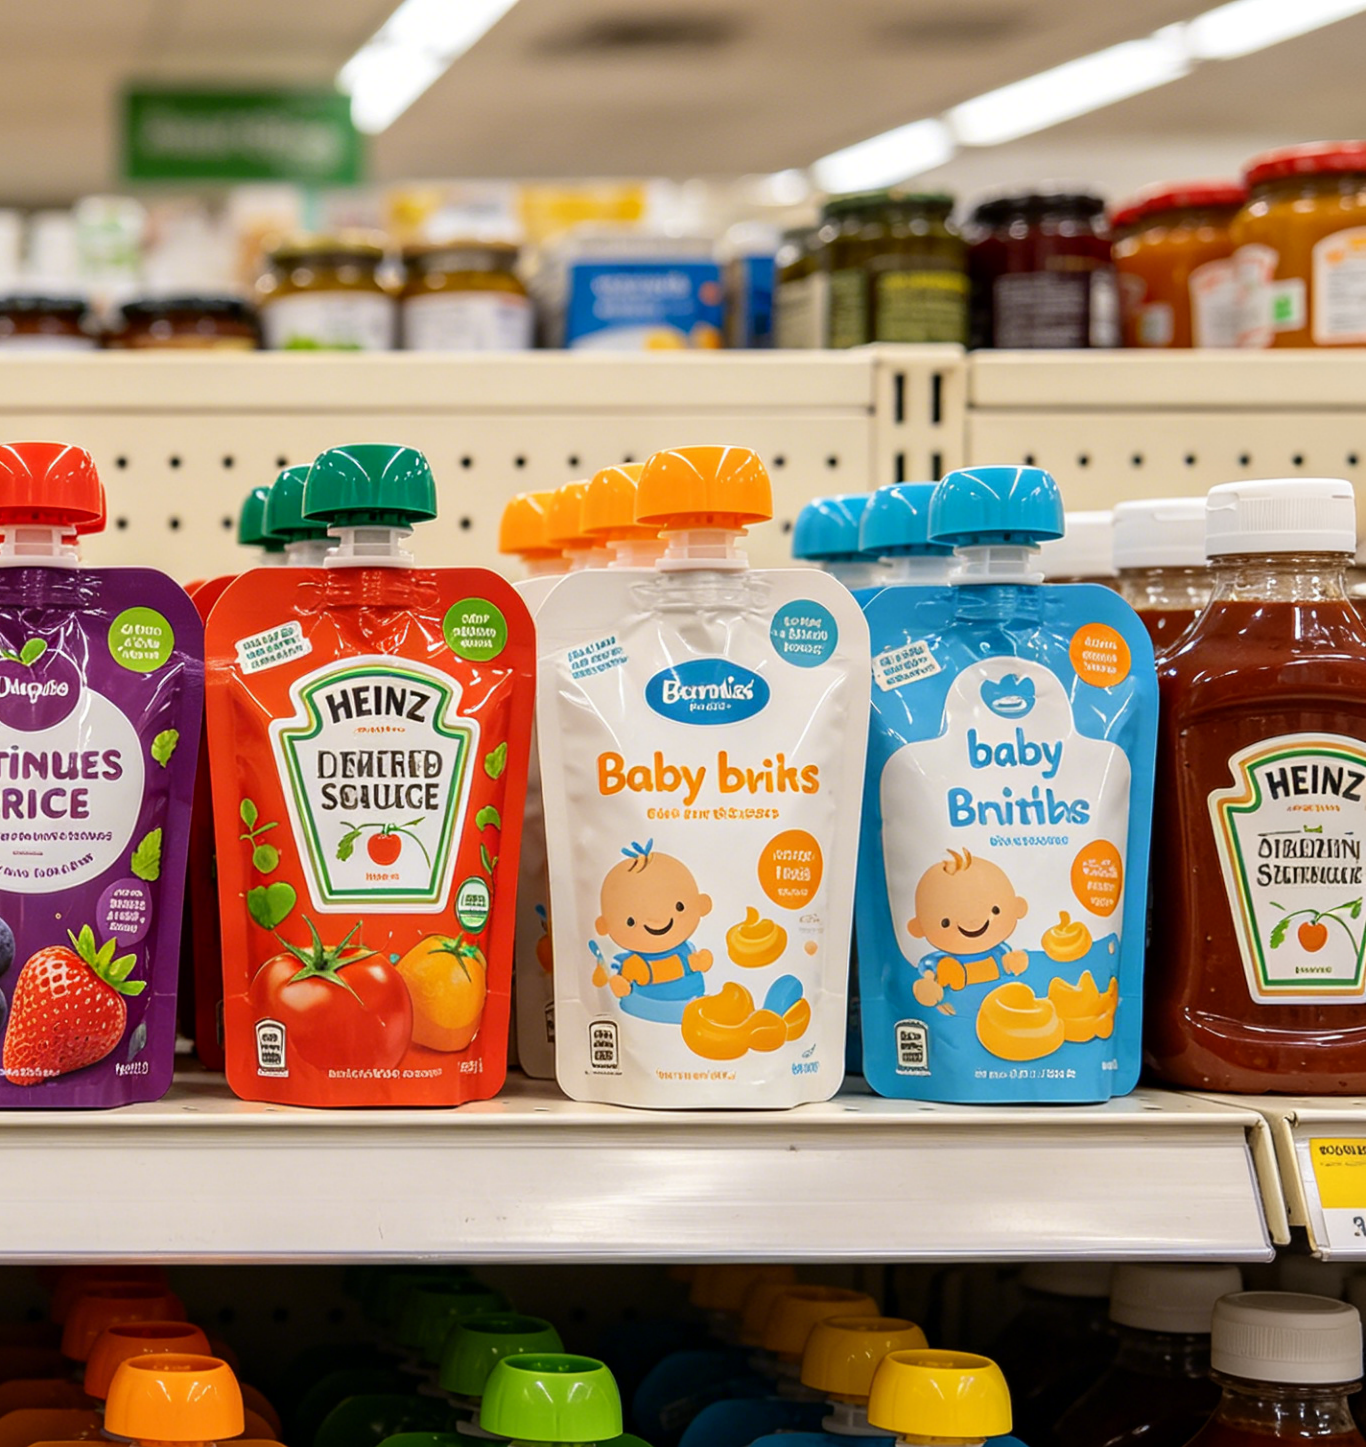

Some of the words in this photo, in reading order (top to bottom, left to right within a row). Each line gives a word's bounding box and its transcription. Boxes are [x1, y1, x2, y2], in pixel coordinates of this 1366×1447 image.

[325, 685, 432, 724] HEINZ
[966, 727, 1064, 780] baby
[597, 750, 706, 806] Baby
[1265, 765, 1366, 802] HEINZ
